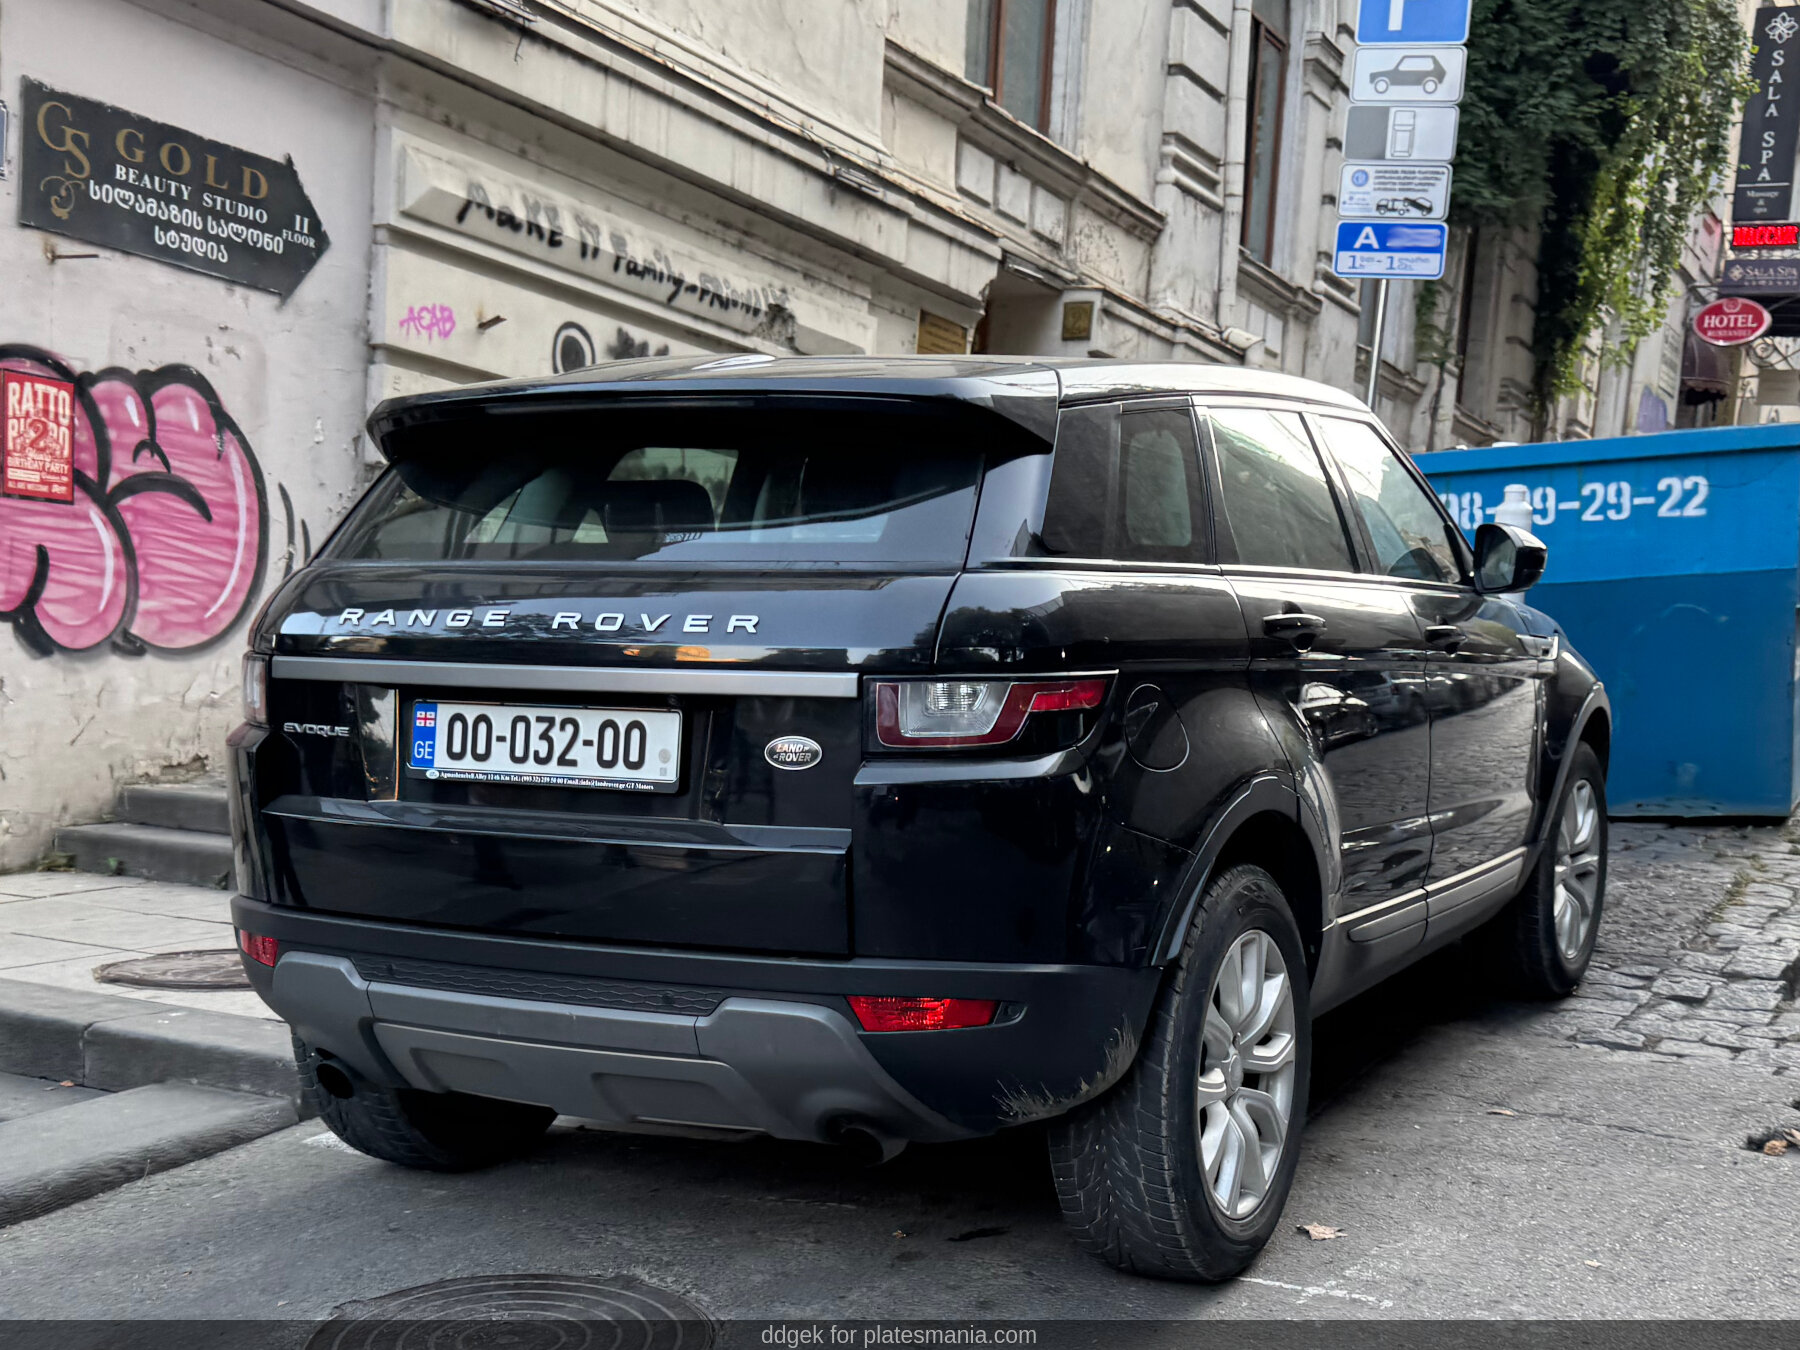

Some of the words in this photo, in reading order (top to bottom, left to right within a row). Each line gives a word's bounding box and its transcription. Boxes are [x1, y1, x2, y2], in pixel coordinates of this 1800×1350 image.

[1765, 50, 1784, 118] SALA
[116, 128, 269, 200] GOLD
[1757, 131, 1775, 181] SPA
[115, 163, 192, 201] BEAUTY
[202, 192, 268, 224] STUDIO
[89, 179, 203, 231] სილამაზის
[207, 215, 284, 255] სალონი
[154, 225, 229, 264] სტუდია
[282, 229, 316, 249] FLOOR
[1353, 226, 1380, 250] A
[1703, 314, 1758, 329] HOTEL
[7, 381, 71, 427] RATTO
[45, 460, 69, 474] PARTY
[338, 607, 512, 628] RANGE
[551, 611, 760, 634] ROVER
[283, 722, 351, 738] EVOQUE
[446, 712, 647, 771] 00-032-00
[414, 741, 434, 760] GE
[776, 743, 804, 753] LAND
[778, 752, 812, 762] ROVER
